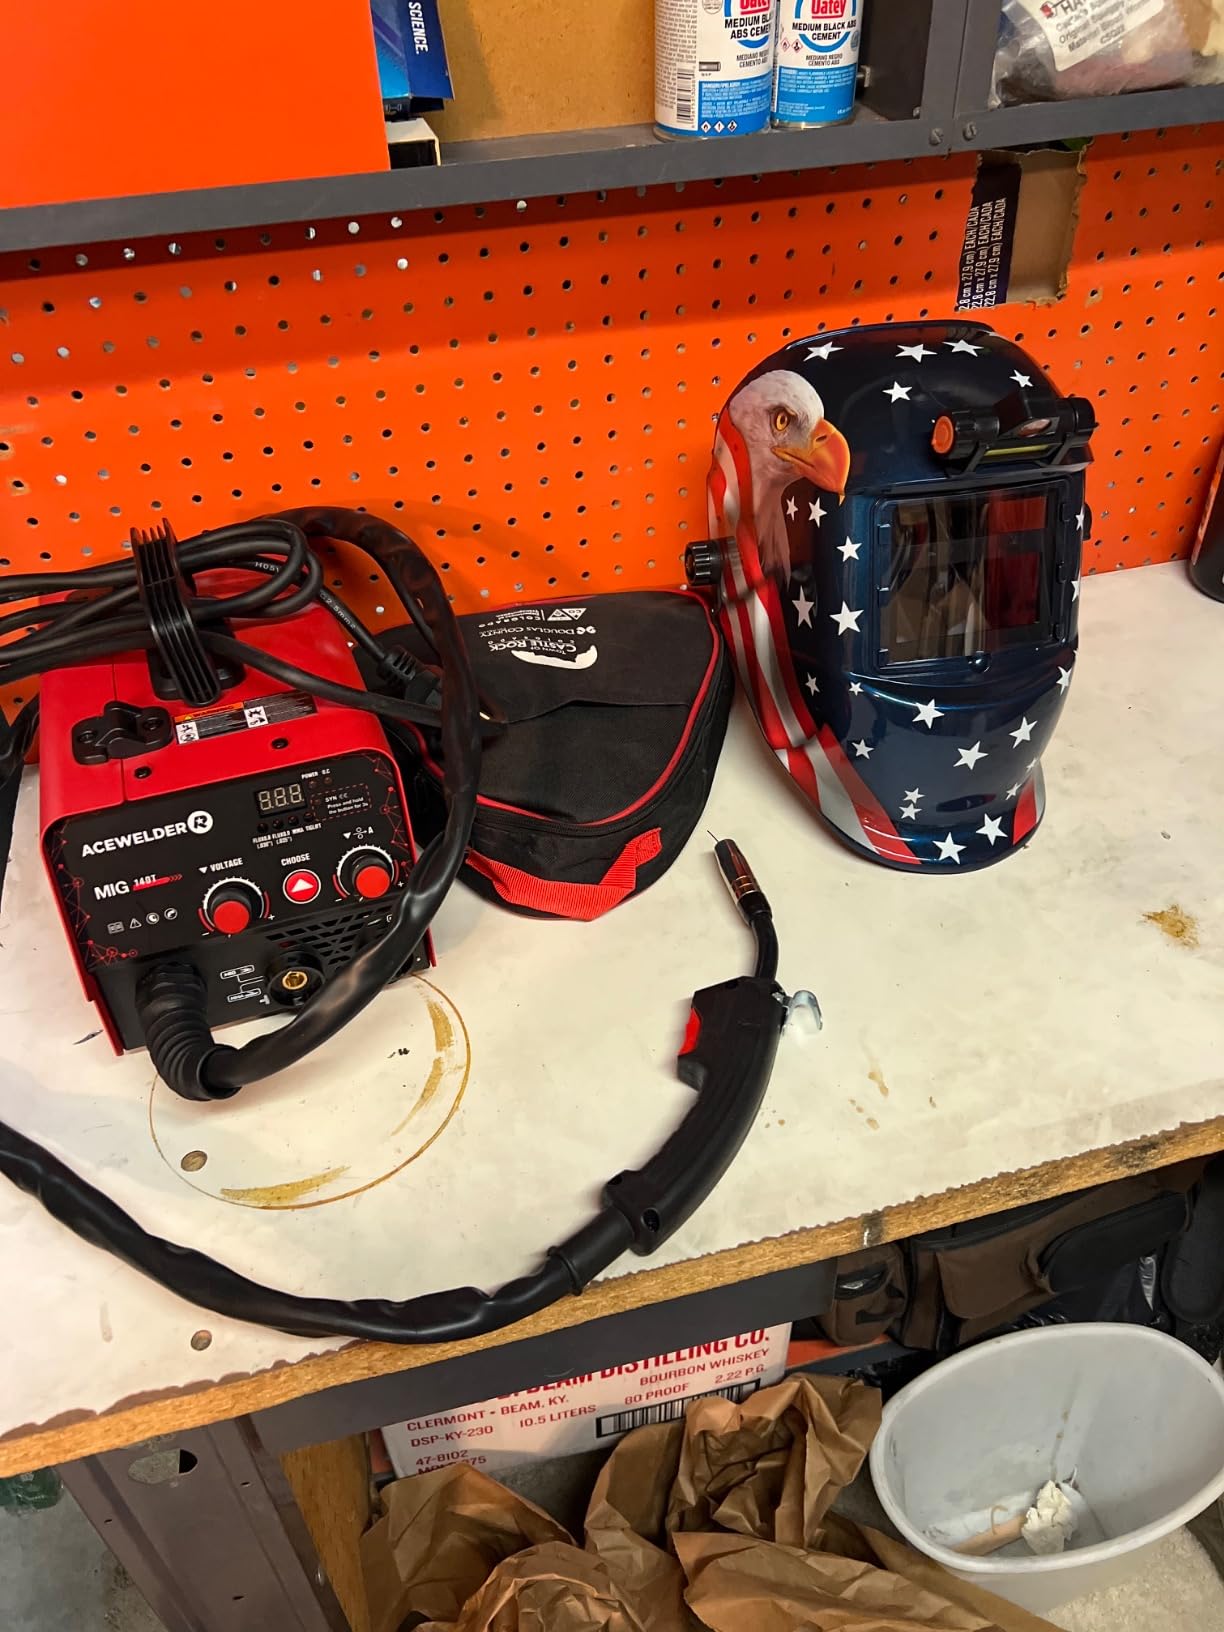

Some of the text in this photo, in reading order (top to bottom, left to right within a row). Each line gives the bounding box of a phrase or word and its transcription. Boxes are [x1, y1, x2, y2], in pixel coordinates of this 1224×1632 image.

[408, 1, 429, 55] SCIENCE.
[725, 15, 760, 28] MEDIUM
[792, 20, 857, 31] MEDIUM BLACK ABS
[730, 28, 748, 39] ABS
[812, 31, 841, 41] CEMENT
[964, 206, 980, 250] EACH/CADA
[978, 201, 993, 245] EACH/CADA
[991, 198, 1007, 241] EACH/CADA
[963, 287, 972, 298] cm
[976, 282, 985, 294] cm
[988, 278, 997, 289] cm
[488, 640, 527, 652] ROCK
[81, 821, 188, 858] ACEWELDER
[209, 857, 244, 873] VOLTAGE
[280, 853, 311, 867] CHOOSE
[93, 880, 130, 900] MIG
[640, 1347, 770, 1387] BOURBON WHISKEY
[549, 1404, 597, 1421] LITERS
[624, 1393, 643, 1406] 80
[645, 1382, 690, 1402] PROOF
[714, 1370, 743, 1385] 2.22
[406, 1410, 486, 1432] CLERMONT
[411, 1425, 494, 1448] DSP-KY-230
